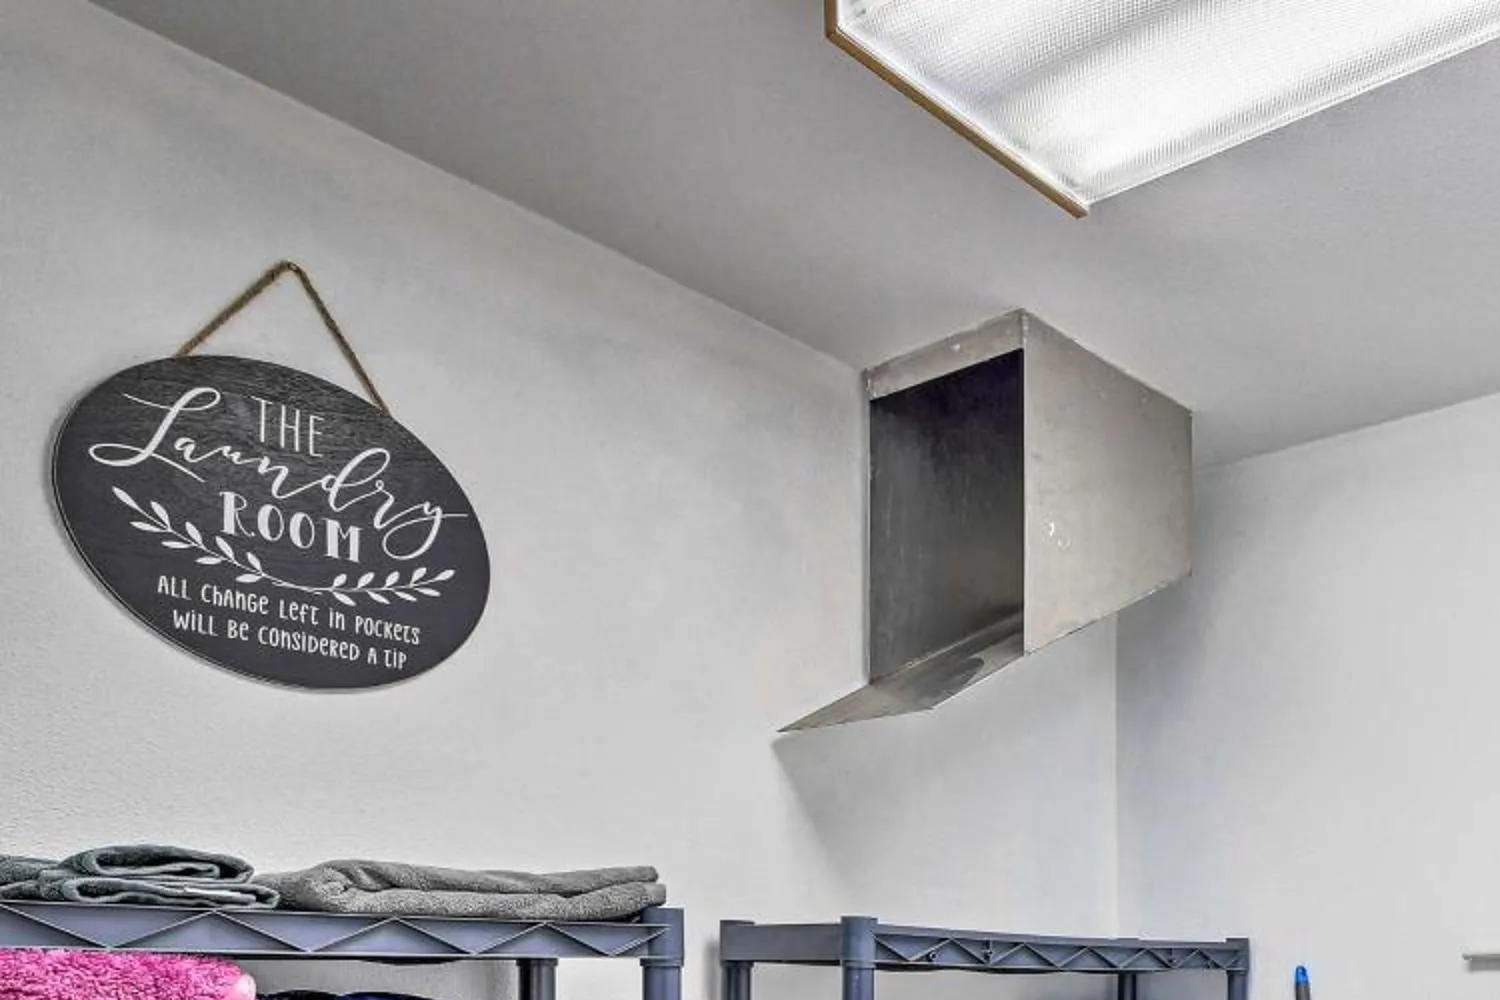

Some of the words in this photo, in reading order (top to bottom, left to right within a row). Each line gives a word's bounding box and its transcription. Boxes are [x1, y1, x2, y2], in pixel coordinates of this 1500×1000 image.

[251, 396, 324, 457] THE
[89, 387, 468, 560] Laundry
[219, 491, 362, 562] ROOM
[157, 575, 191, 600] ALL
[367, 647, 377, 665] A
